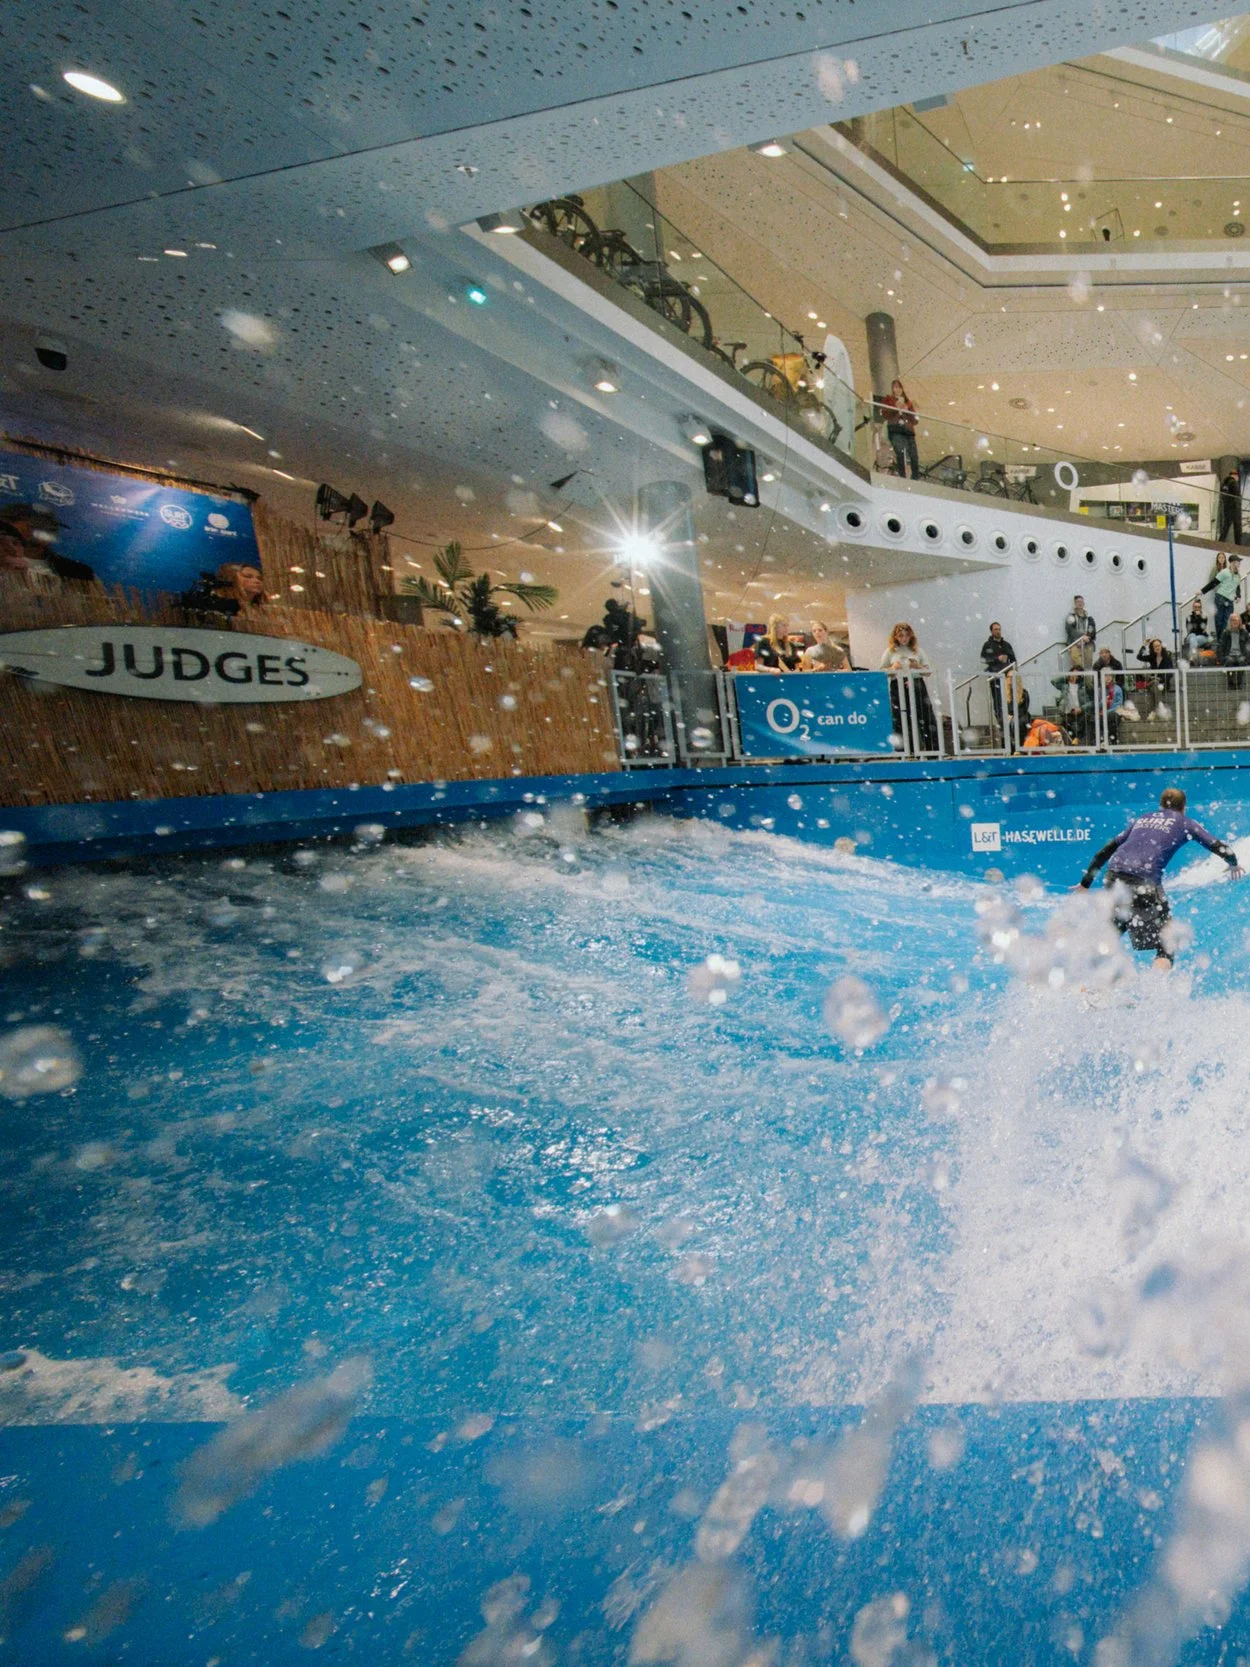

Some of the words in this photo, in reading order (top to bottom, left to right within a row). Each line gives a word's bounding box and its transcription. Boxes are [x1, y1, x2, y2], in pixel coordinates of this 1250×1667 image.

[85, 641, 310, 687] JUDGES
[766, 698, 811, 741] O2
[817, 713, 844, 725] can
[847, 710, 868, 725] do
[974, 831, 998, 844] L&T
